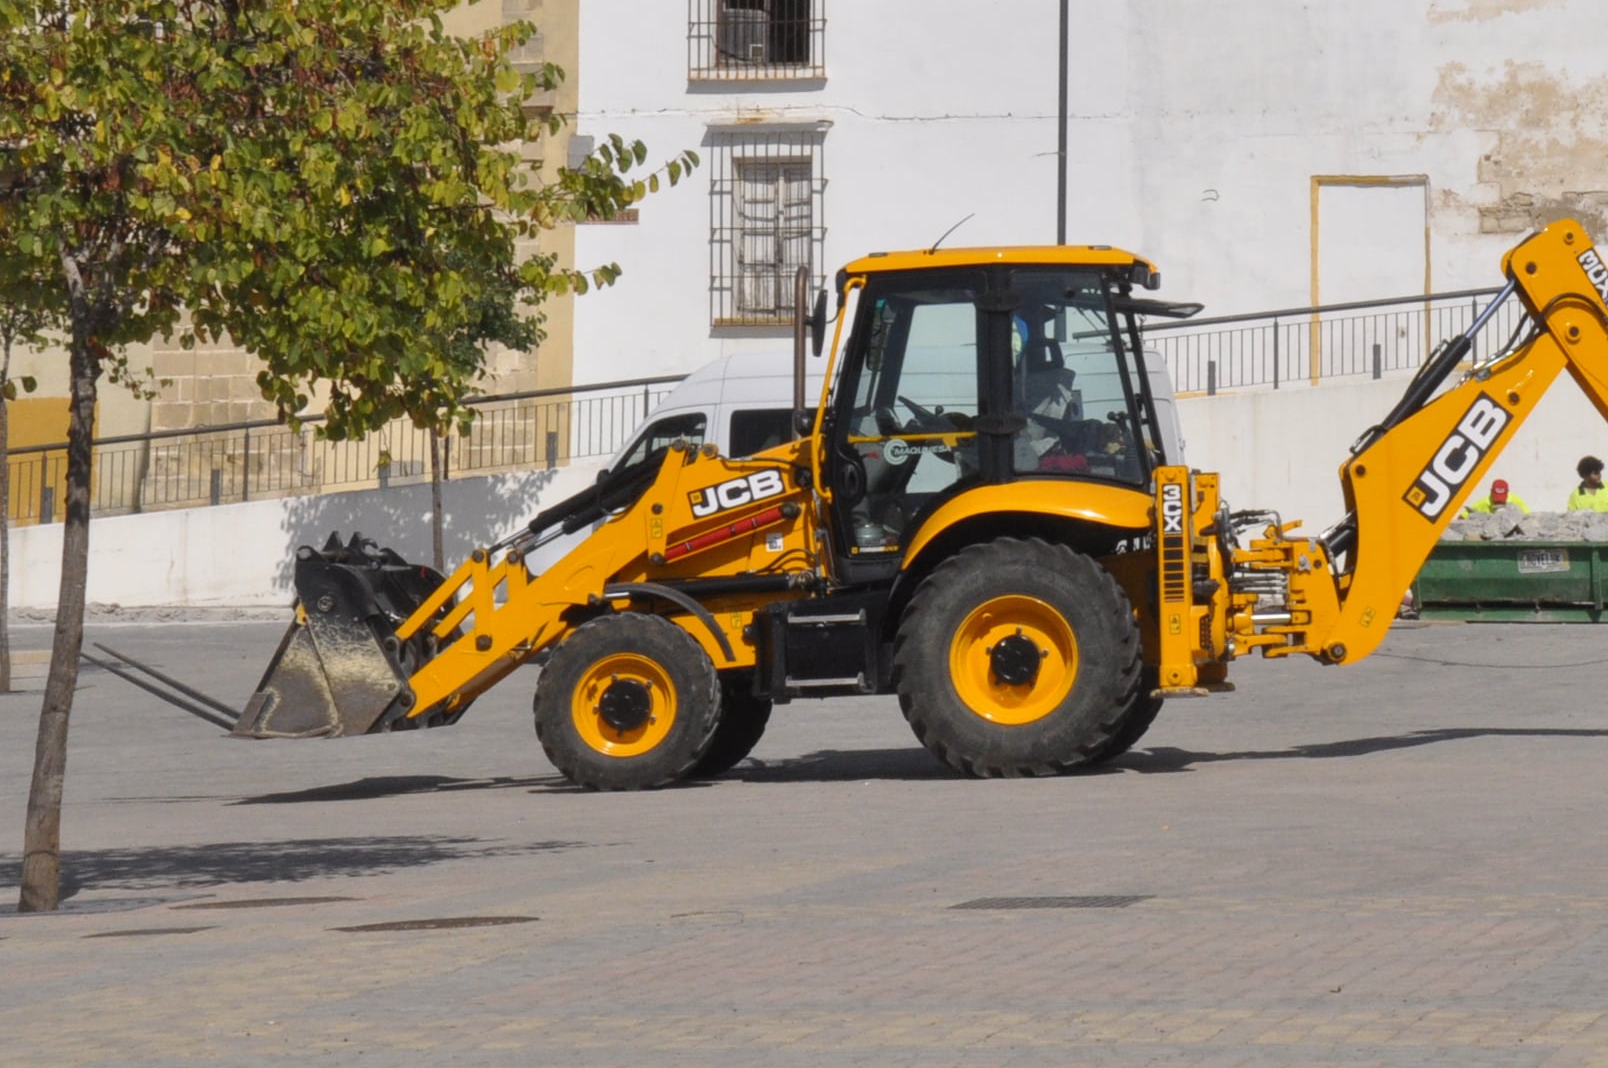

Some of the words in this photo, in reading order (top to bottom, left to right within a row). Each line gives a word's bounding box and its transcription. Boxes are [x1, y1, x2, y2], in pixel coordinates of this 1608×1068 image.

[1420, 397, 1508, 517] JCB
[692, 469, 784, 517] JCB
[1162, 484, 1183, 533] 3CX
